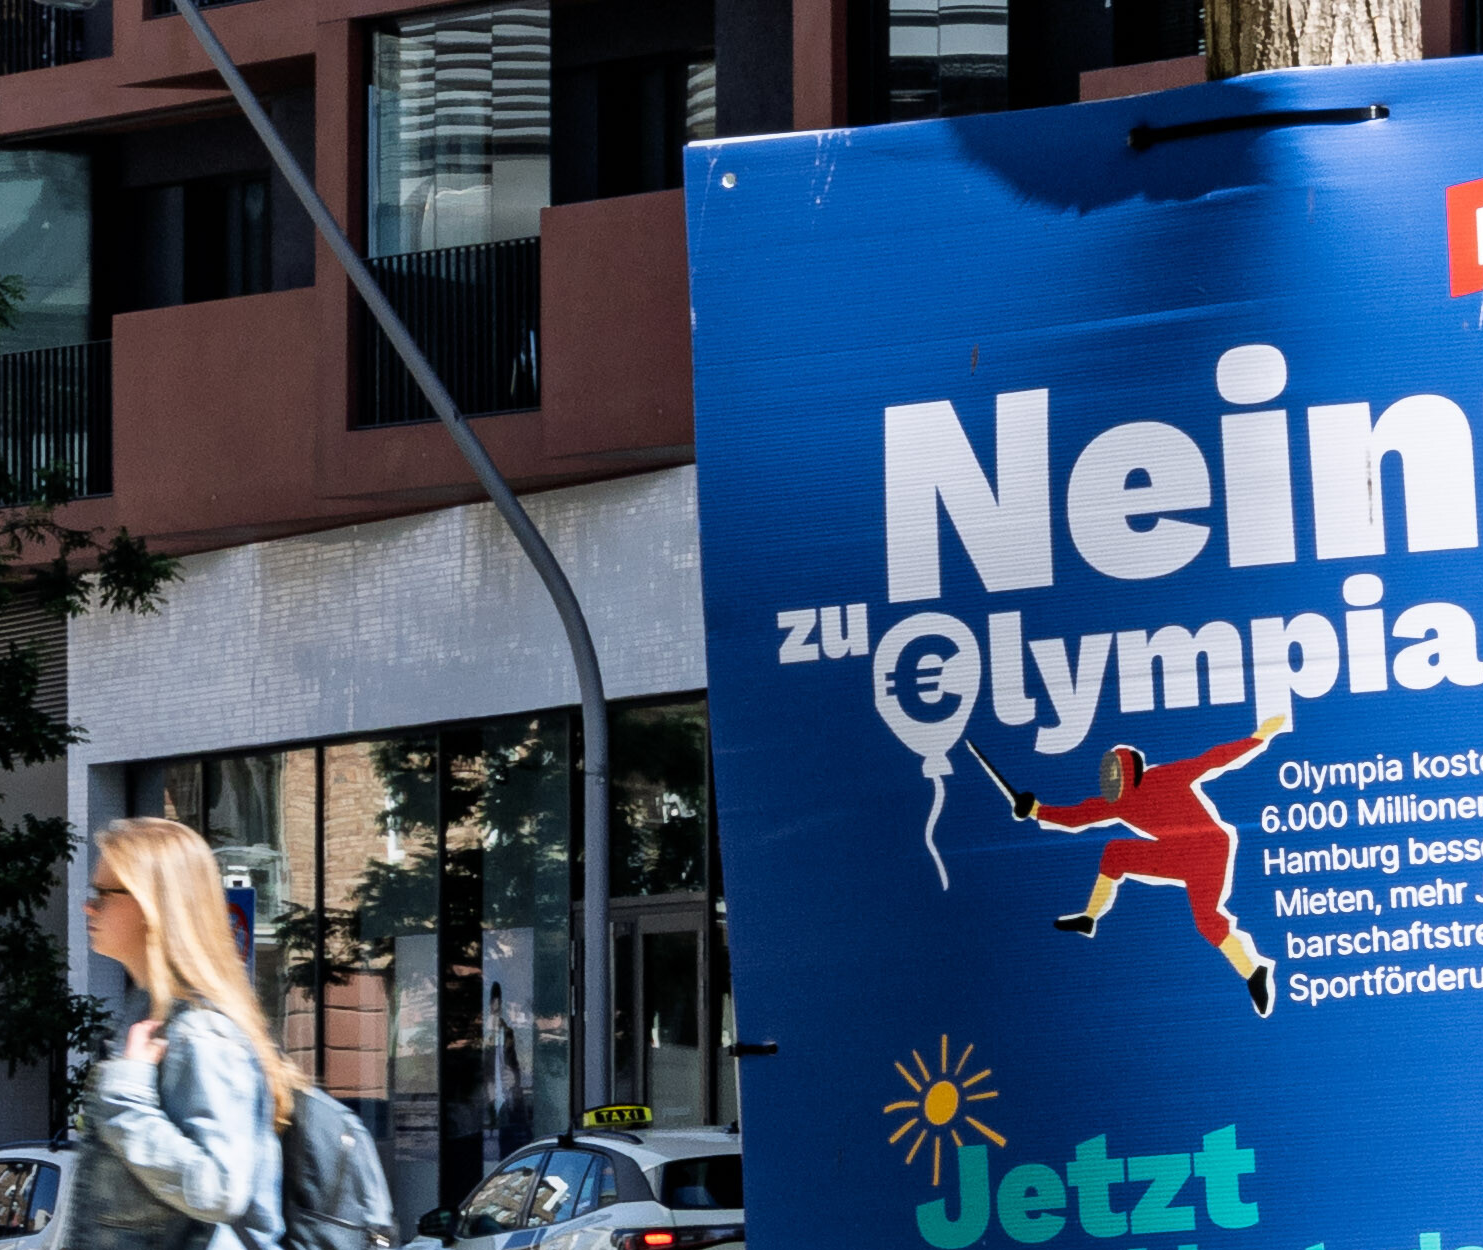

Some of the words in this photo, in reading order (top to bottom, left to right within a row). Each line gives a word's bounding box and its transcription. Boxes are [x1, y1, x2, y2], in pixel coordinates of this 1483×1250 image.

[777, 603, 871, 665] zu
[1279, 754, 1403, 794] Olympia
[1260, 799, 1347, 834] 6.000
[1263, 840, 1400, 878] Hamburg
[1275, 885, 1383, 919] Mieten,
[1389, 875, 1468, 909] mehr
[598, 1108, 640, 1122] TAXI
[916, 1123, 1260, 1250] Jetzt
